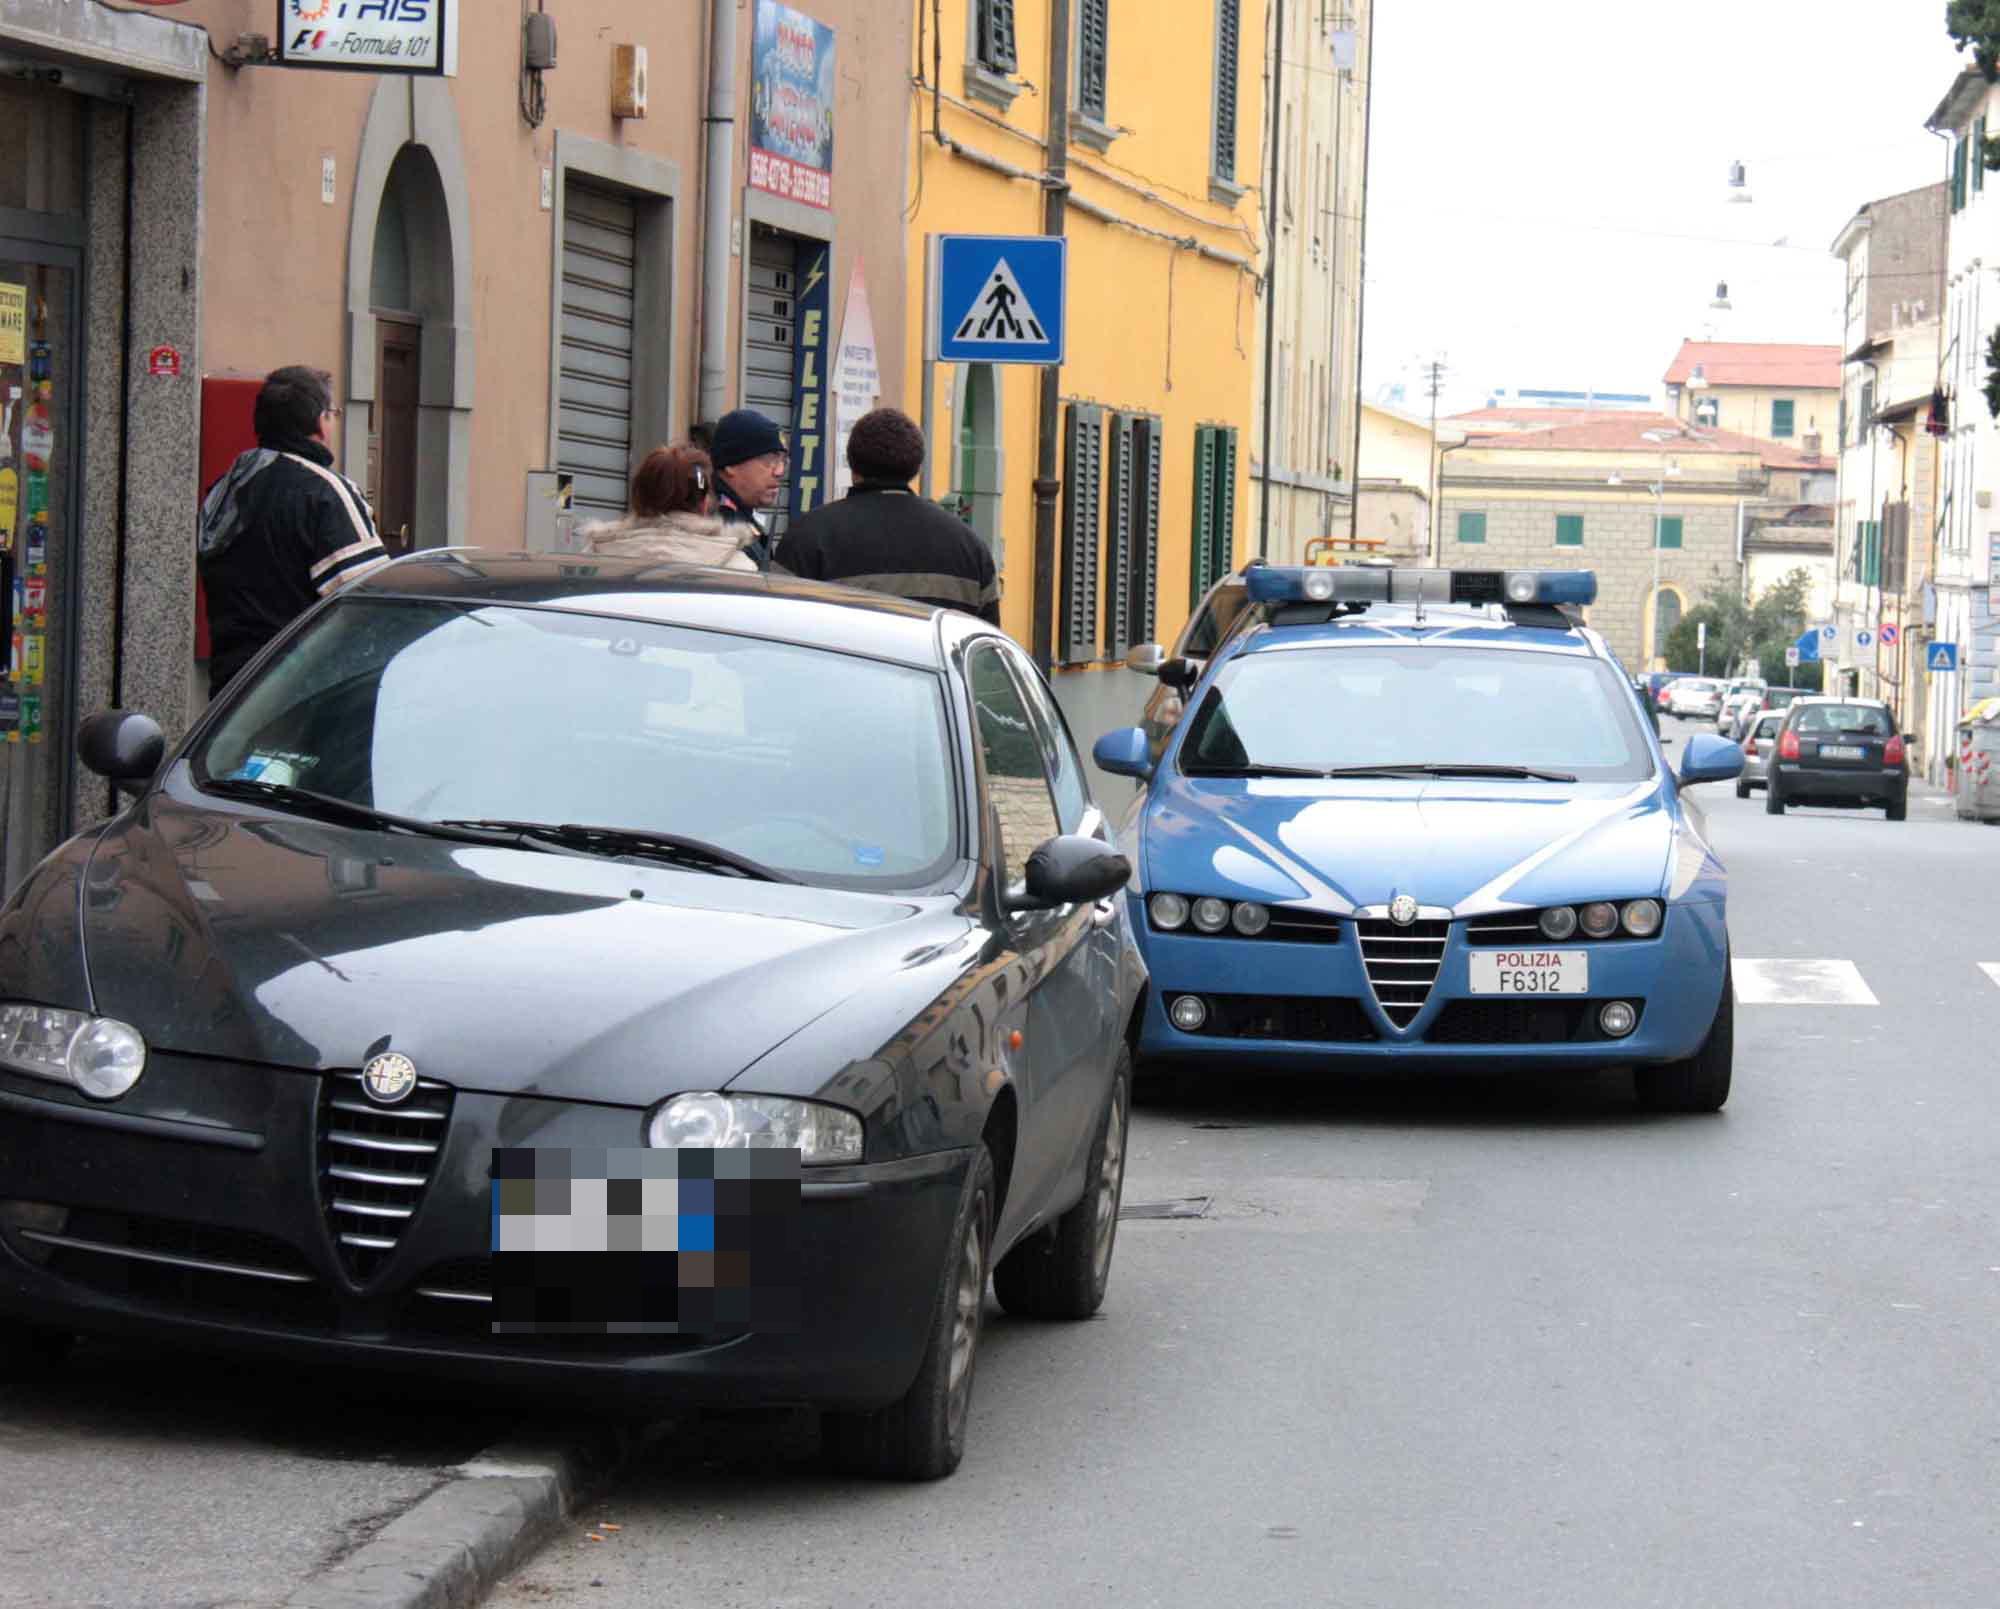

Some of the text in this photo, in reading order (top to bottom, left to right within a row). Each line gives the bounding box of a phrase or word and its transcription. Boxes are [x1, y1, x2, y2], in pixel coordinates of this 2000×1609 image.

[340, 32, 401, 56] Formula
[404, 36, 432, 57] 101
[1496, 953, 1562, 967] POLIZIA
[1500, 971, 1560, 992] F6312
